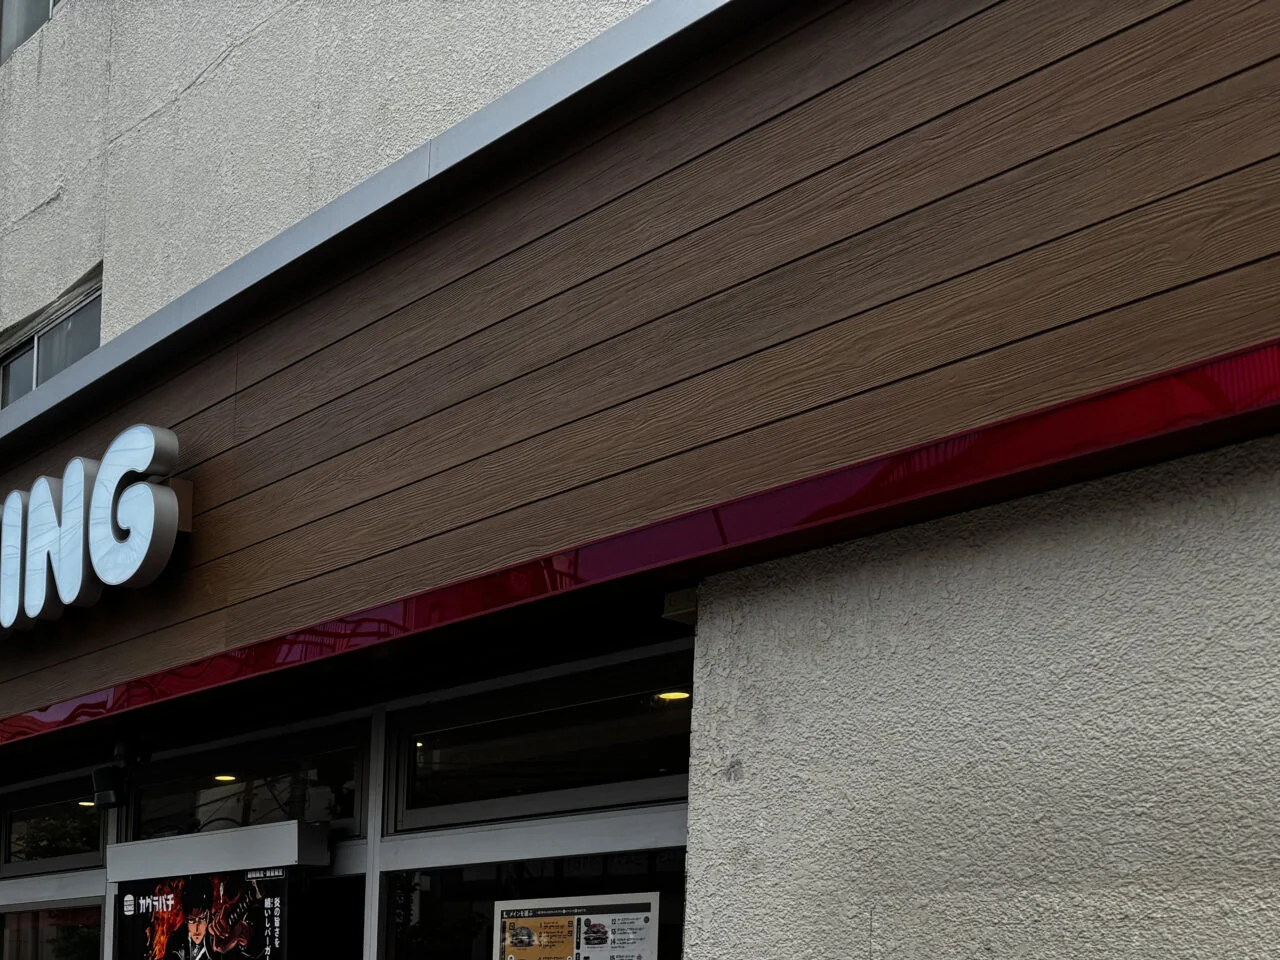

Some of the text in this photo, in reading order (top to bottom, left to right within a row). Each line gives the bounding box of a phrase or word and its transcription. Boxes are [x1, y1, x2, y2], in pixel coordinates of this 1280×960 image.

[138, 893, 175, 913] カグラバチ
